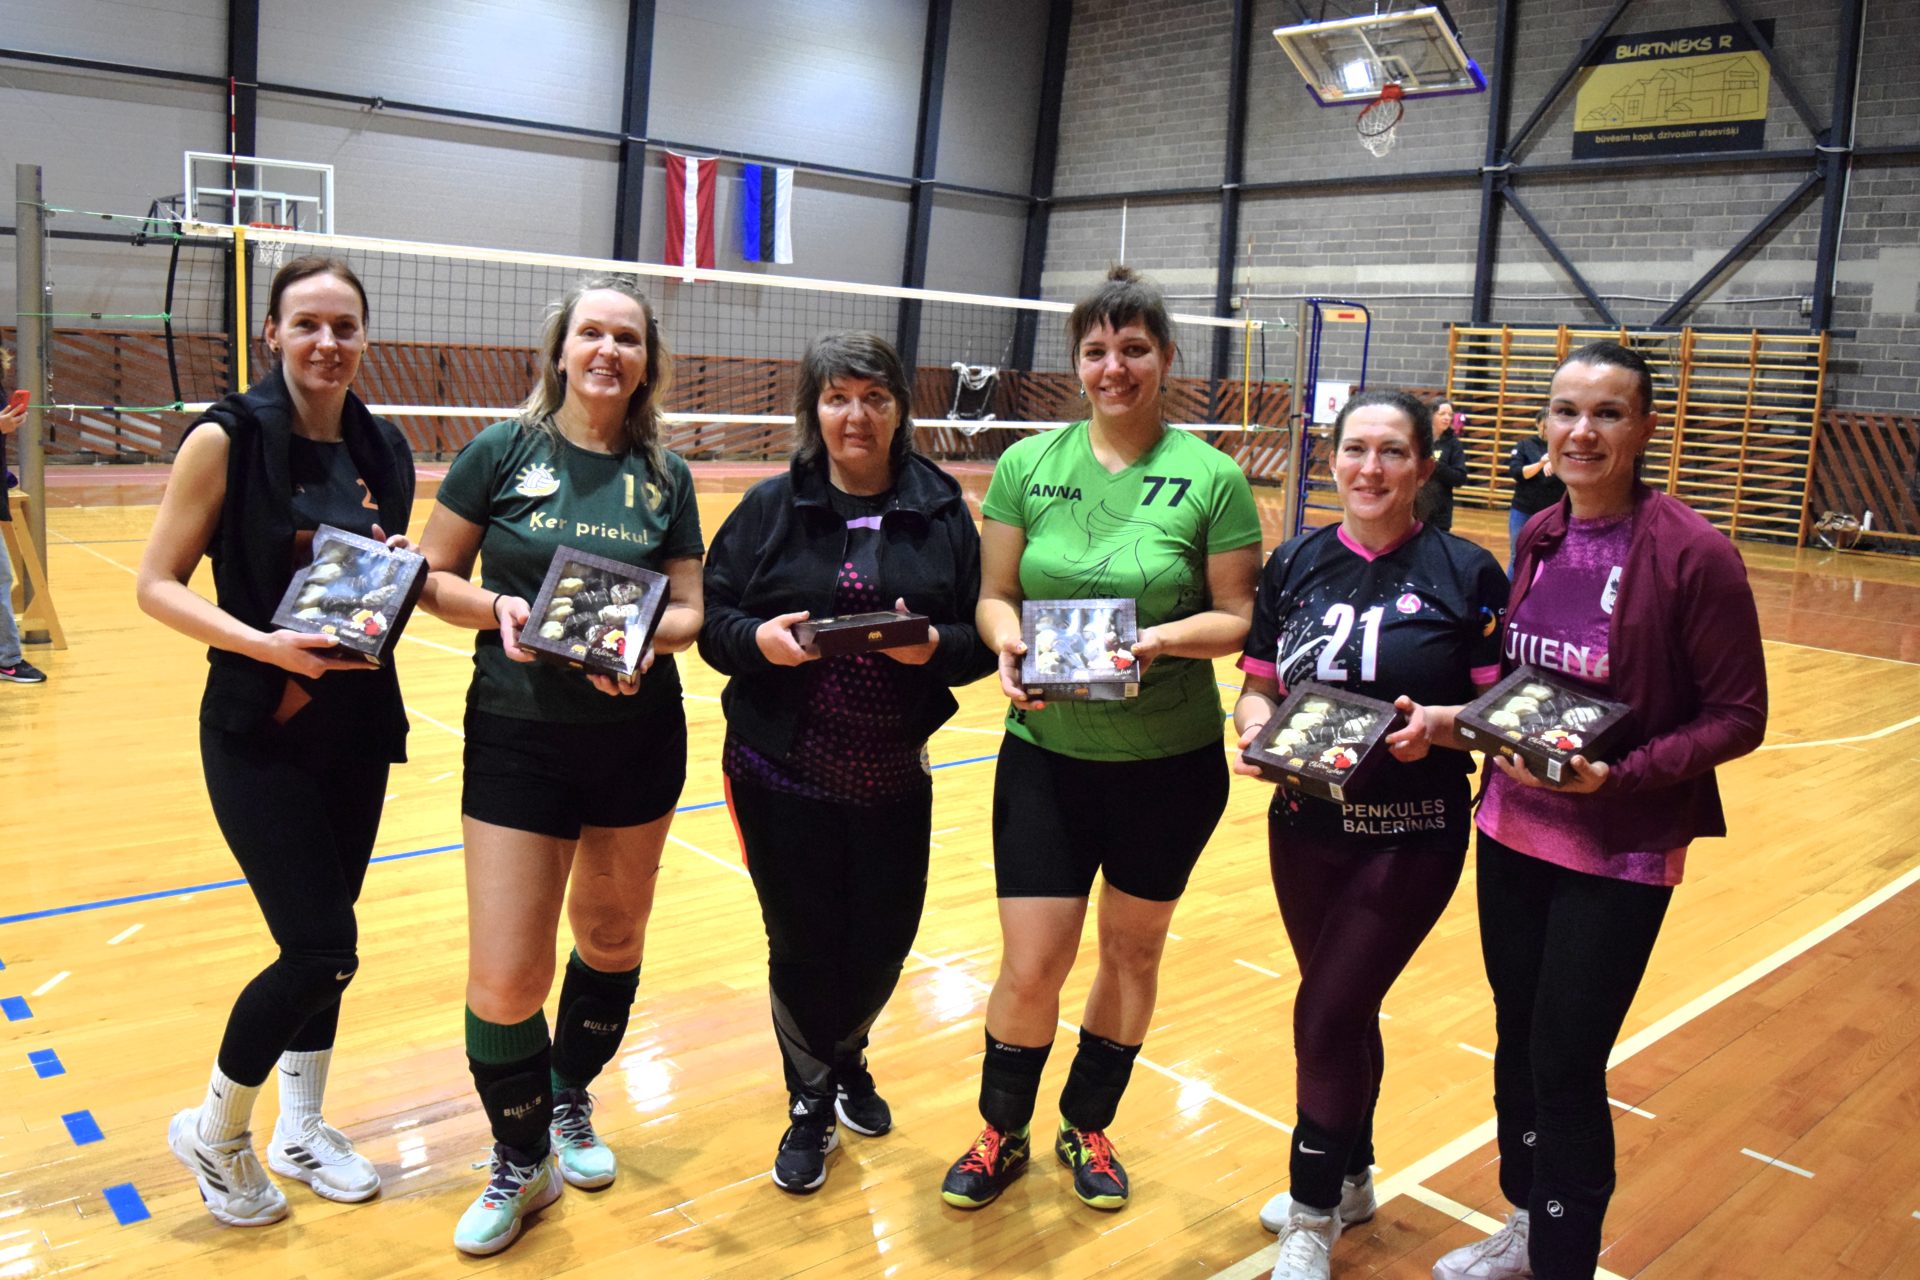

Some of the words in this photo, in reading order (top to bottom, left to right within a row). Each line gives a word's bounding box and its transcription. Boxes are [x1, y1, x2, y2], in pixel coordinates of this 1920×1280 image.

[1616, 36, 1712, 59] BURTNIEKS
[1719, 35, 1734, 48] R
[1029, 483, 1082, 501] ANNA
[1140, 475, 1192, 508] 77
[576, 522, 649, 546] prieku!
[1317, 602, 1385, 682] 21
[1342, 799, 1446, 818] PENKULES
[1343, 816, 1446, 835] BALERĪNAS
